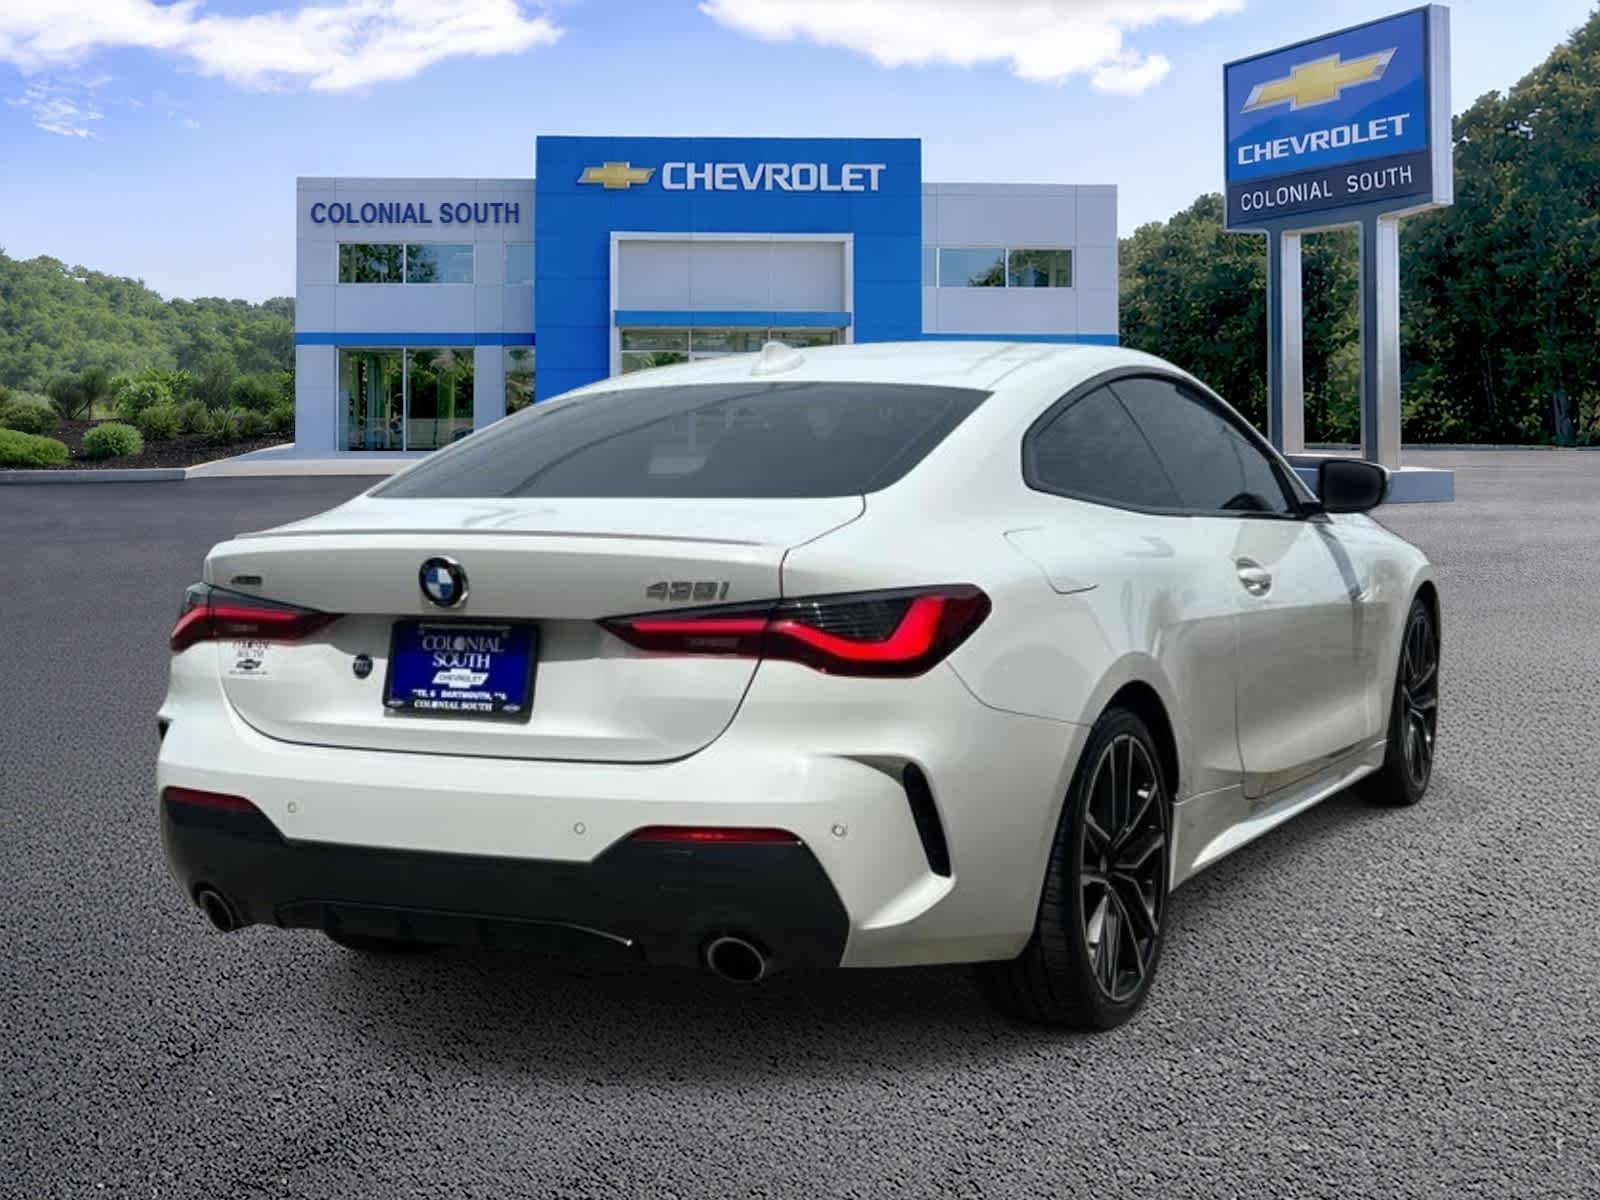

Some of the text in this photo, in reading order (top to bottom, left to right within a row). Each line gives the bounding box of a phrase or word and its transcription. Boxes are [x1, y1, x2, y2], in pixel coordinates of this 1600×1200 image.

[1237, 113, 1410, 165] CHEVROLET
[662, 162, 886, 192] CHEVROLET
[1240, 165, 1413, 212] COLONIAL SOUTH
[310, 202, 520, 224] COLONIAL SOUTH
[422, 635, 504, 652] COLONIAL
[432, 651, 490, 668] SOUTH
[461, 702, 493, 711] SOUTH
